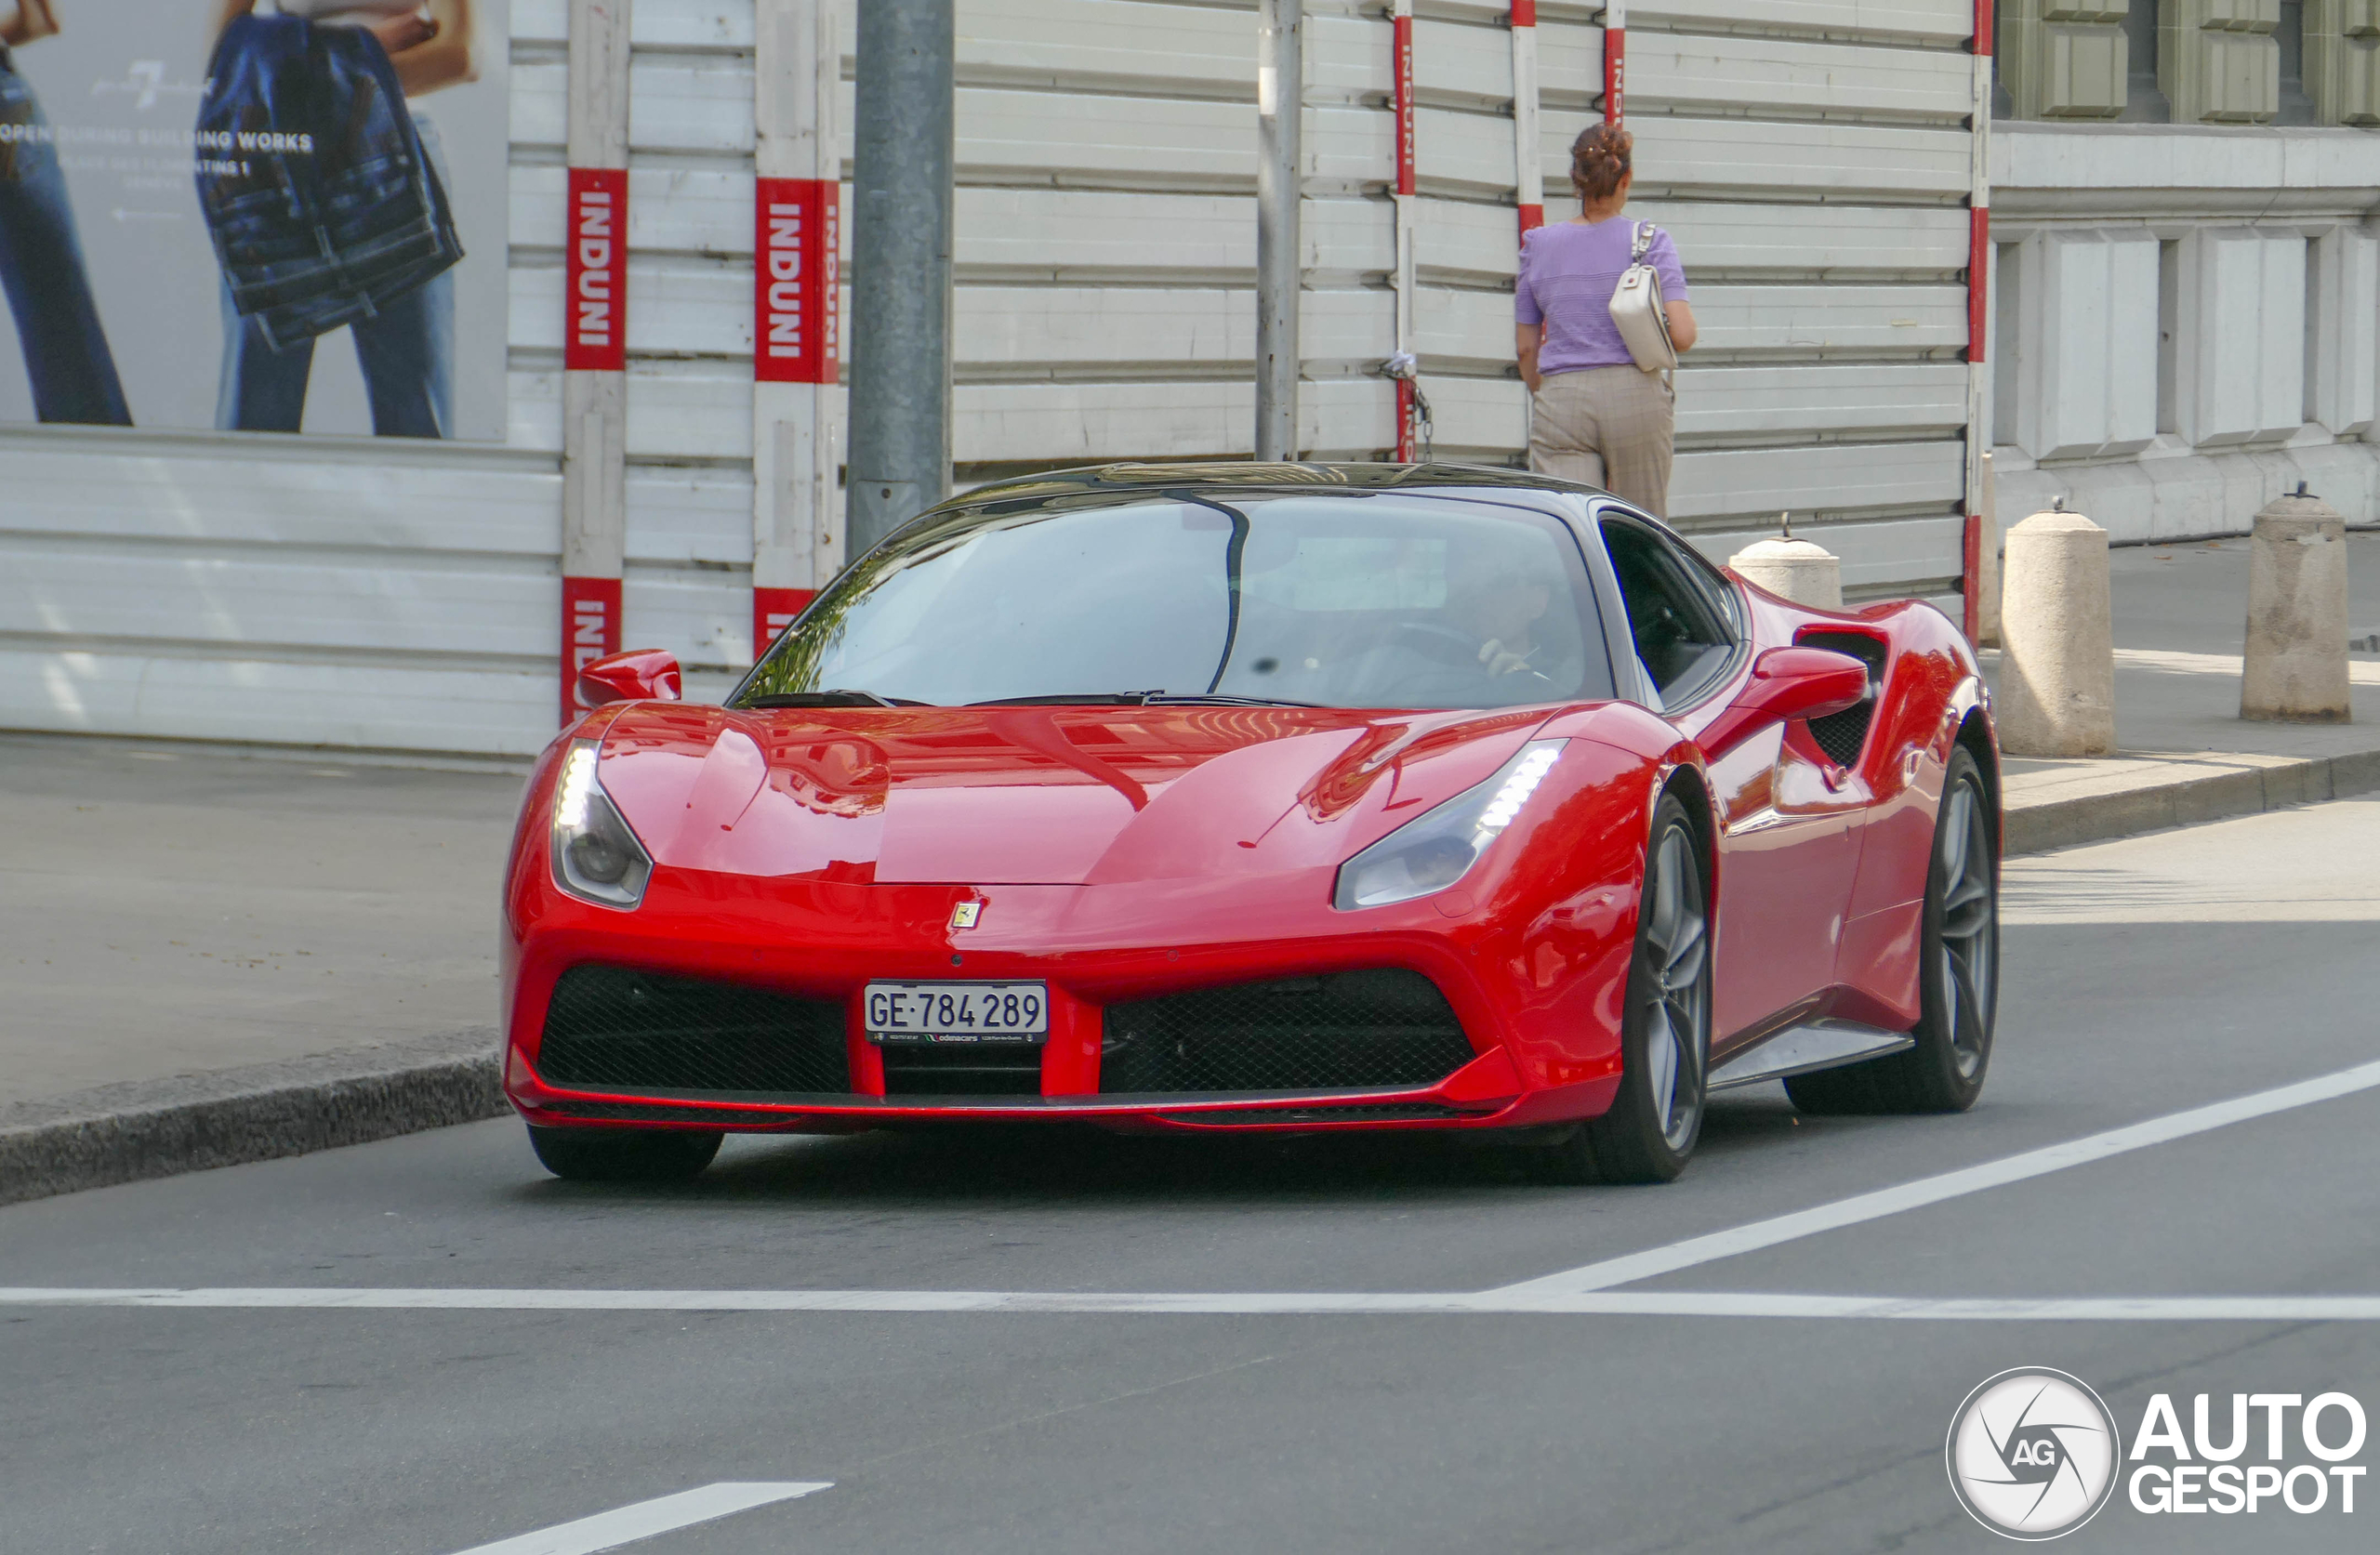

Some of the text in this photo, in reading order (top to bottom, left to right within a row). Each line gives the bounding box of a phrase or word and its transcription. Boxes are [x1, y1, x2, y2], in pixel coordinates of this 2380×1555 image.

[0, 124, 313, 152] OPEN DURING BUILDING WORKS
[1402, 45, 1413, 165] INDUNI
[578, 191, 611, 346] INDUNI
[769, 203, 800, 358] INDUNI
[826, 204, 837, 358] INDUNI
[982, 993, 1040, 1028] 289
